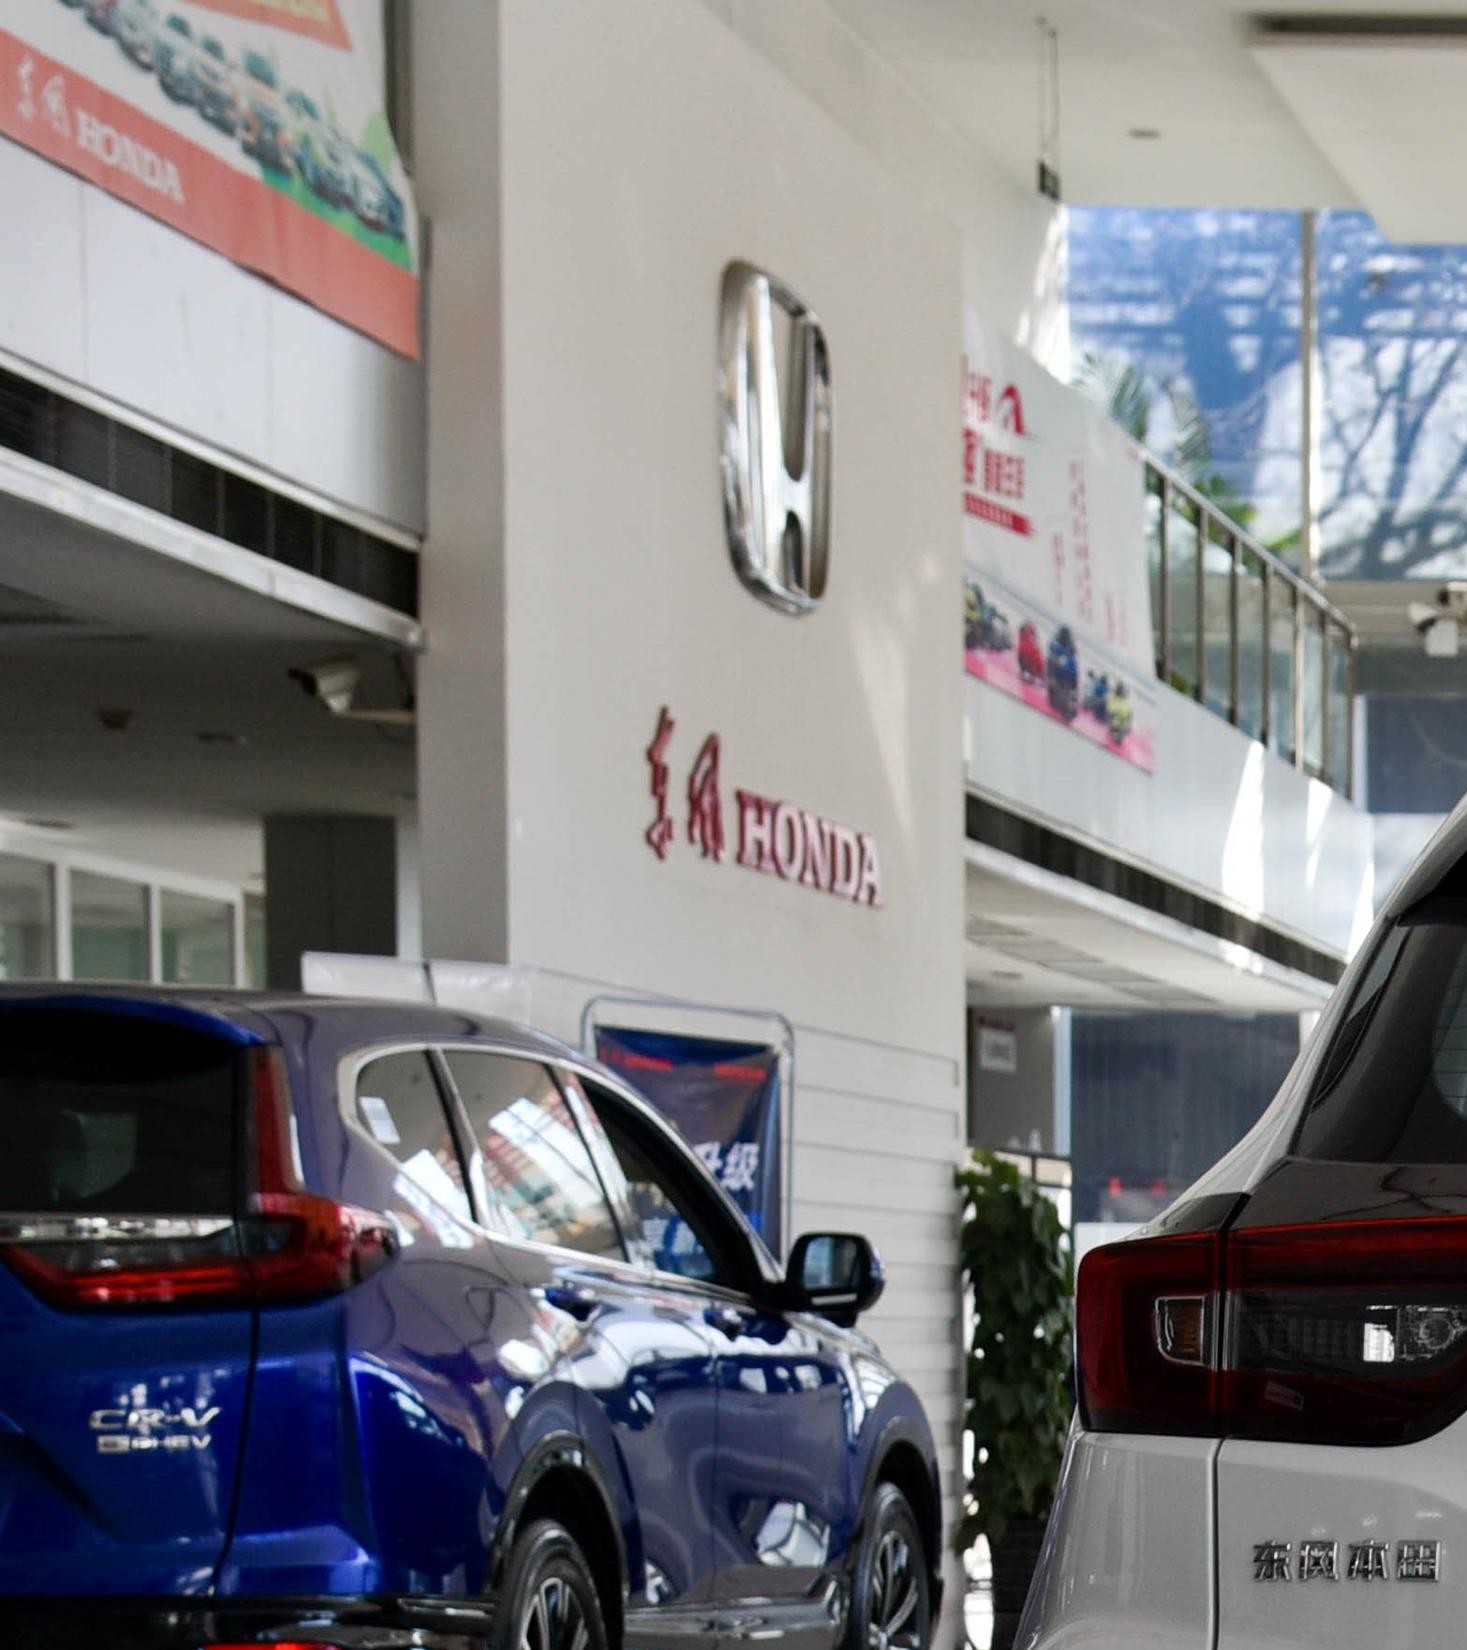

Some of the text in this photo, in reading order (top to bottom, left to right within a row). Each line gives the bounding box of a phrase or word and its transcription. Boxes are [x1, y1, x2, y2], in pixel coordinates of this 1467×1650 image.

[75, 107, 187, 205] HONDA
[734, 787, 884, 908] HONDA
[89, 1406, 221, 1430] CR-V
[1252, 1538, 1441, 1582] 东风本田
